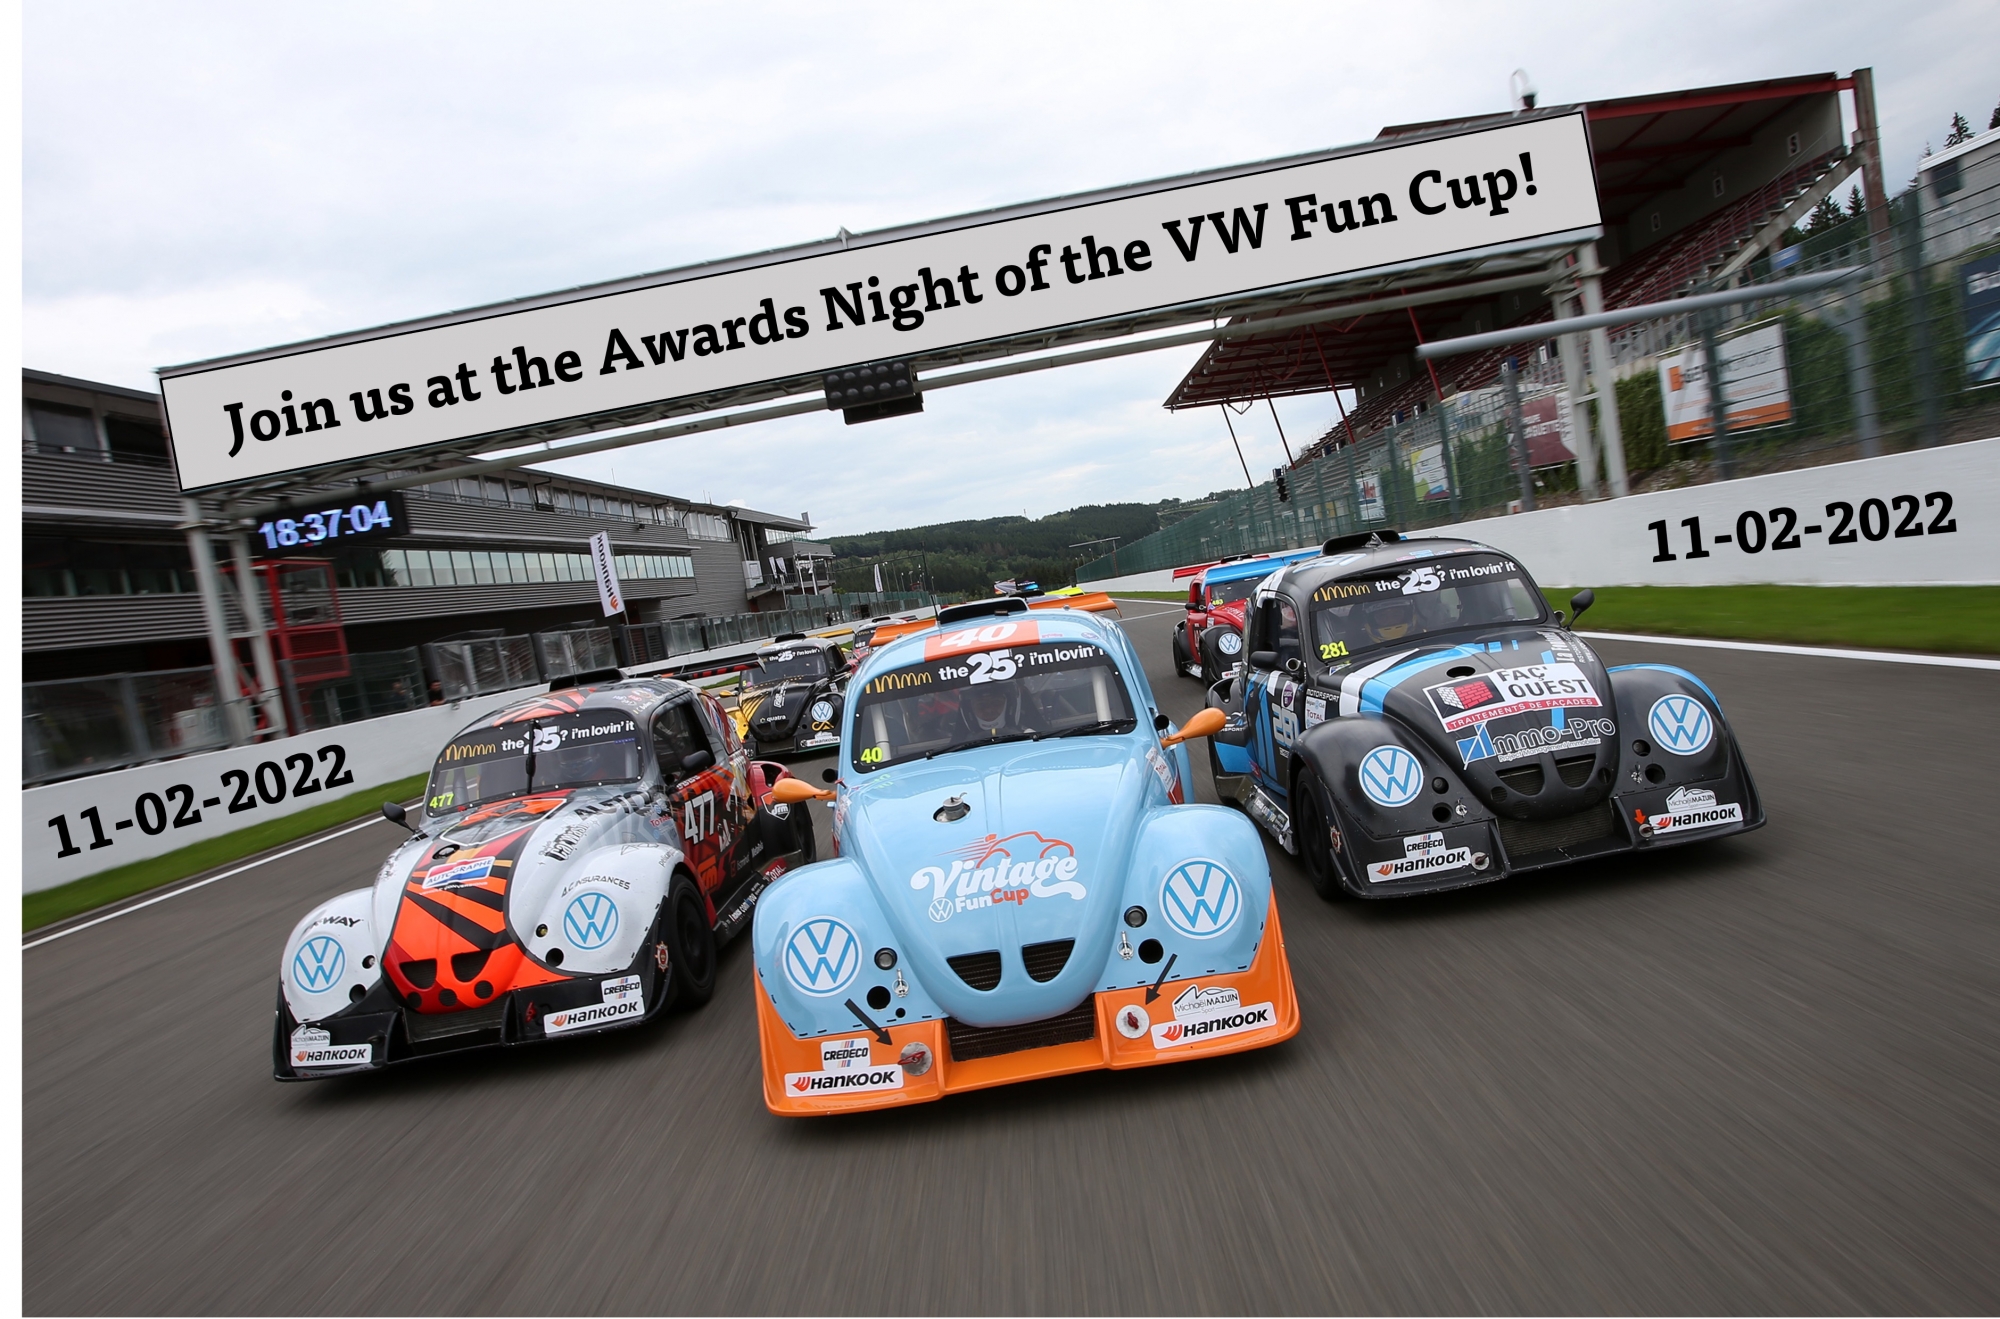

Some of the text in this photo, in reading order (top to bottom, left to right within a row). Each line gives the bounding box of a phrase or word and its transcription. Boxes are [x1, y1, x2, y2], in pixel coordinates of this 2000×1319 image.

[224, 150, 1539, 458] Join us at the Awards Night of the VW Fun Cup!
[258, 501, 393, 549] 18:37:04
[1648, 491, 1957, 562] 11-02-2022
[1375, 580, 1401, 592] the
[1449, 569, 1470, 580] i'm
[1471, 562, 1503, 577] lovin'
[1505, 561, 1517, 572] it
[939, 623, 1018, 648] 40
[1320, 640, 1350, 660] 281
[938, 665, 969, 681] the
[1029, 652, 1049, 666] i'm
[1055, 645, 1096, 662] lovin'
[1306, 688, 1339, 703] MOTORSPORT
[1507, 679, 1588, 698] OUEST
[1451, 699, 1593, 728] TRAITEMENTS DE FAÇADES
[501, 738, 524, 751] the
[571, 728, 590, 740] i'm
[591, 720, 624, 737] lovin'
[625, 720, 635, 732] it
[861, 746, 883, 763] 40
[48, 744, 354, 859] 11-02-2022
[429, 793, 454, 809] 477
[685, 790, 714, 844] 477
[1406, 838, 1444, 852] CREDECO
[426, 860, 492, 883] AUTOGRAPHE
[910, 855, 1087, 901] Vintage
[604, 982, 640, 995] CREDECO
[1206, 993, 1239, 1007] MAZUIN
[823, 1047, 868, 1061] CREDECO
